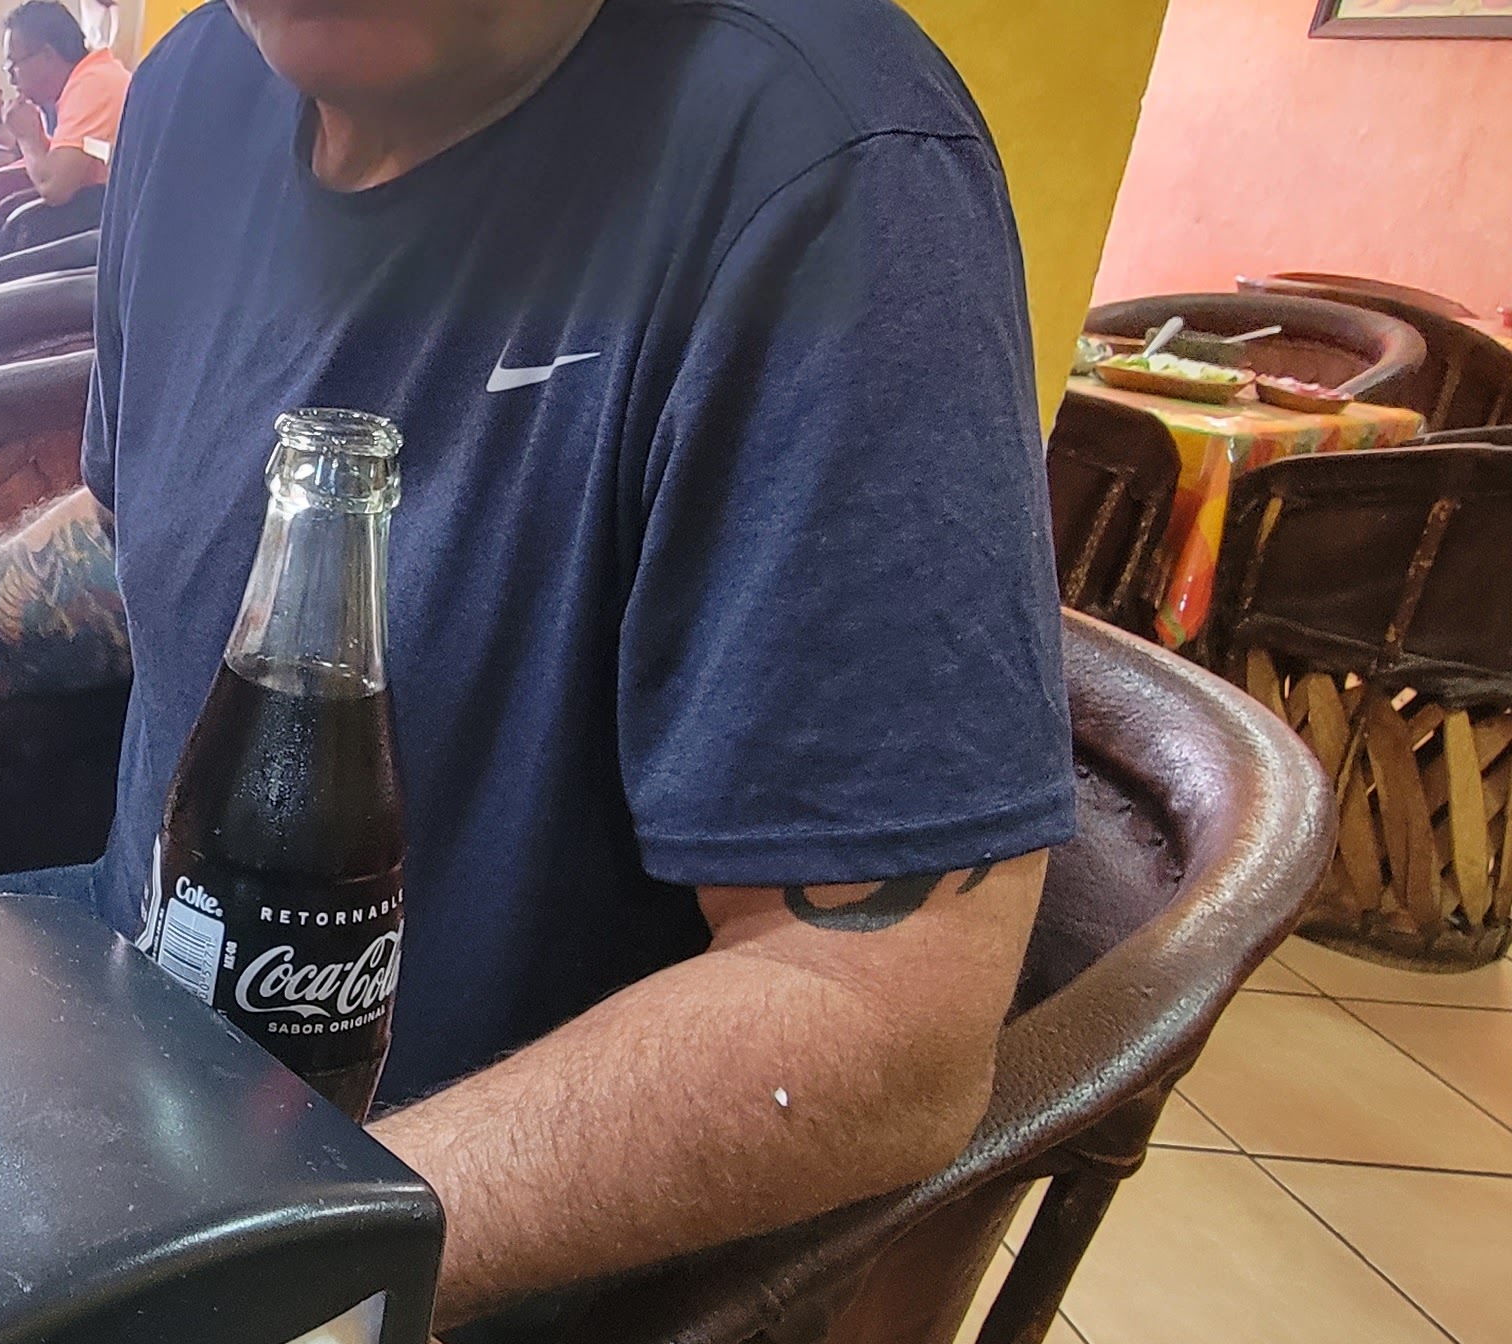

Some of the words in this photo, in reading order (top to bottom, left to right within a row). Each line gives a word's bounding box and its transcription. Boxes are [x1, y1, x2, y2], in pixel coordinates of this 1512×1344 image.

[176, 876, 218, 913] Coke
[261, 888, 403, 926] RETORNABLE
[268, 1022, 323, 1034] SABOR
[330, 1006, 386, 1033] ORIGINAL
